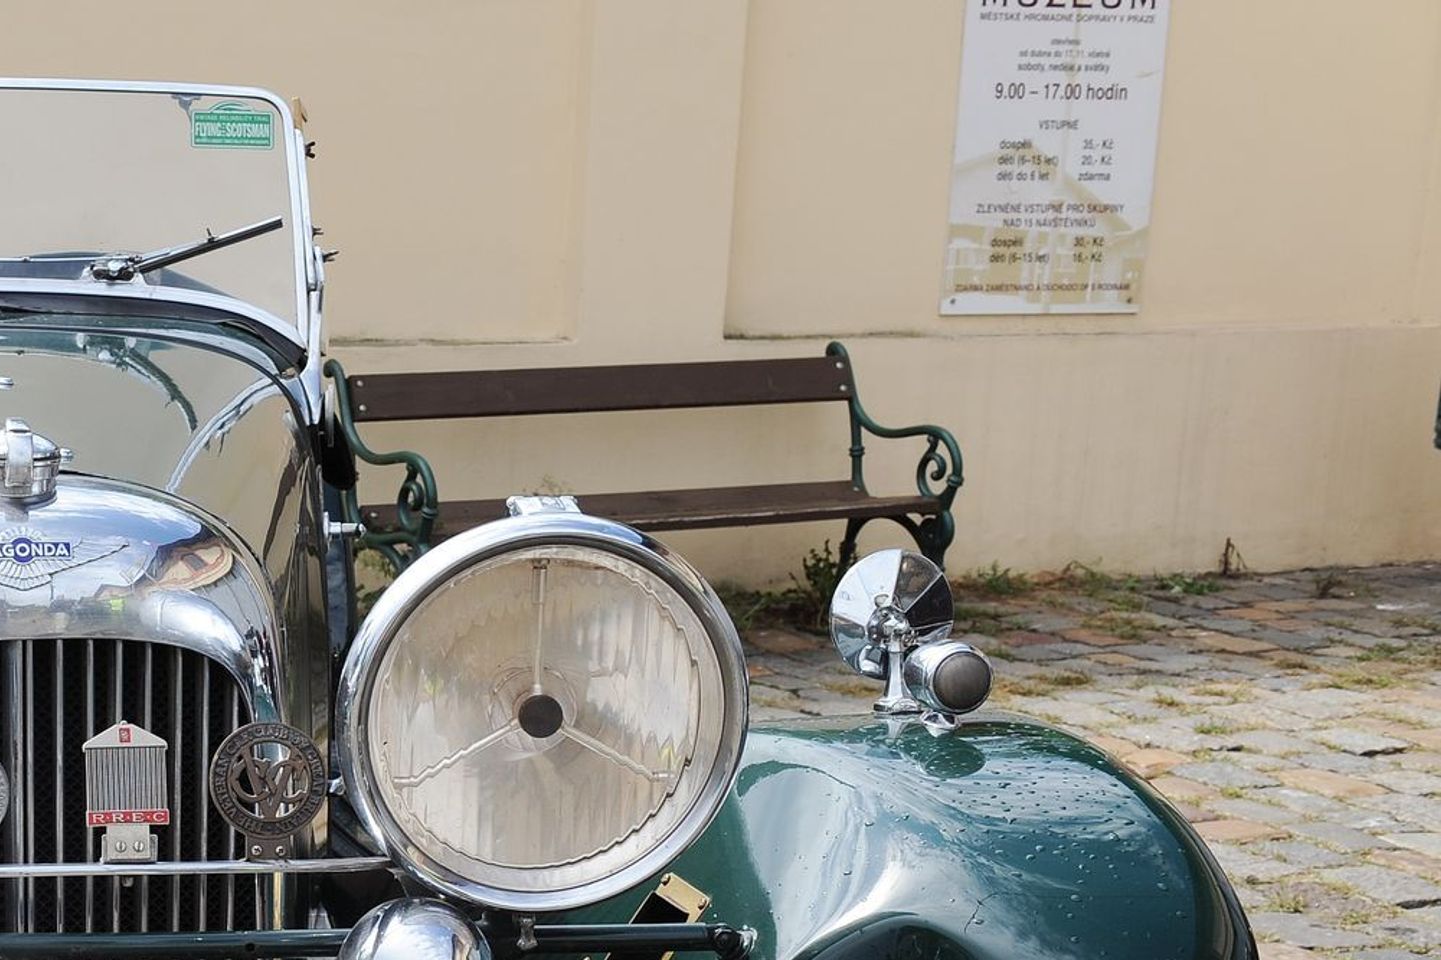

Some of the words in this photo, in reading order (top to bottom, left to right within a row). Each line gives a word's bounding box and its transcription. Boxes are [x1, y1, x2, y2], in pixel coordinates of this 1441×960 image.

[995, 82, 1026, 100] 9.00
[1044, 83, 1082, 100] 17.00
[1086, 83, 1128, 101] hodin
[195, 122, 222, 137] FLYING
[226, 122, 270, 138] SCOTSMAN
[1016, 171, 1028, 181] do
[1078, 171, 1111, 181] zdarma
[1066, 203, 1085, 214] PRO
[1086, 203, 1125, 214] SKUPINY
[1002, 217, 1022, 228] NAD
